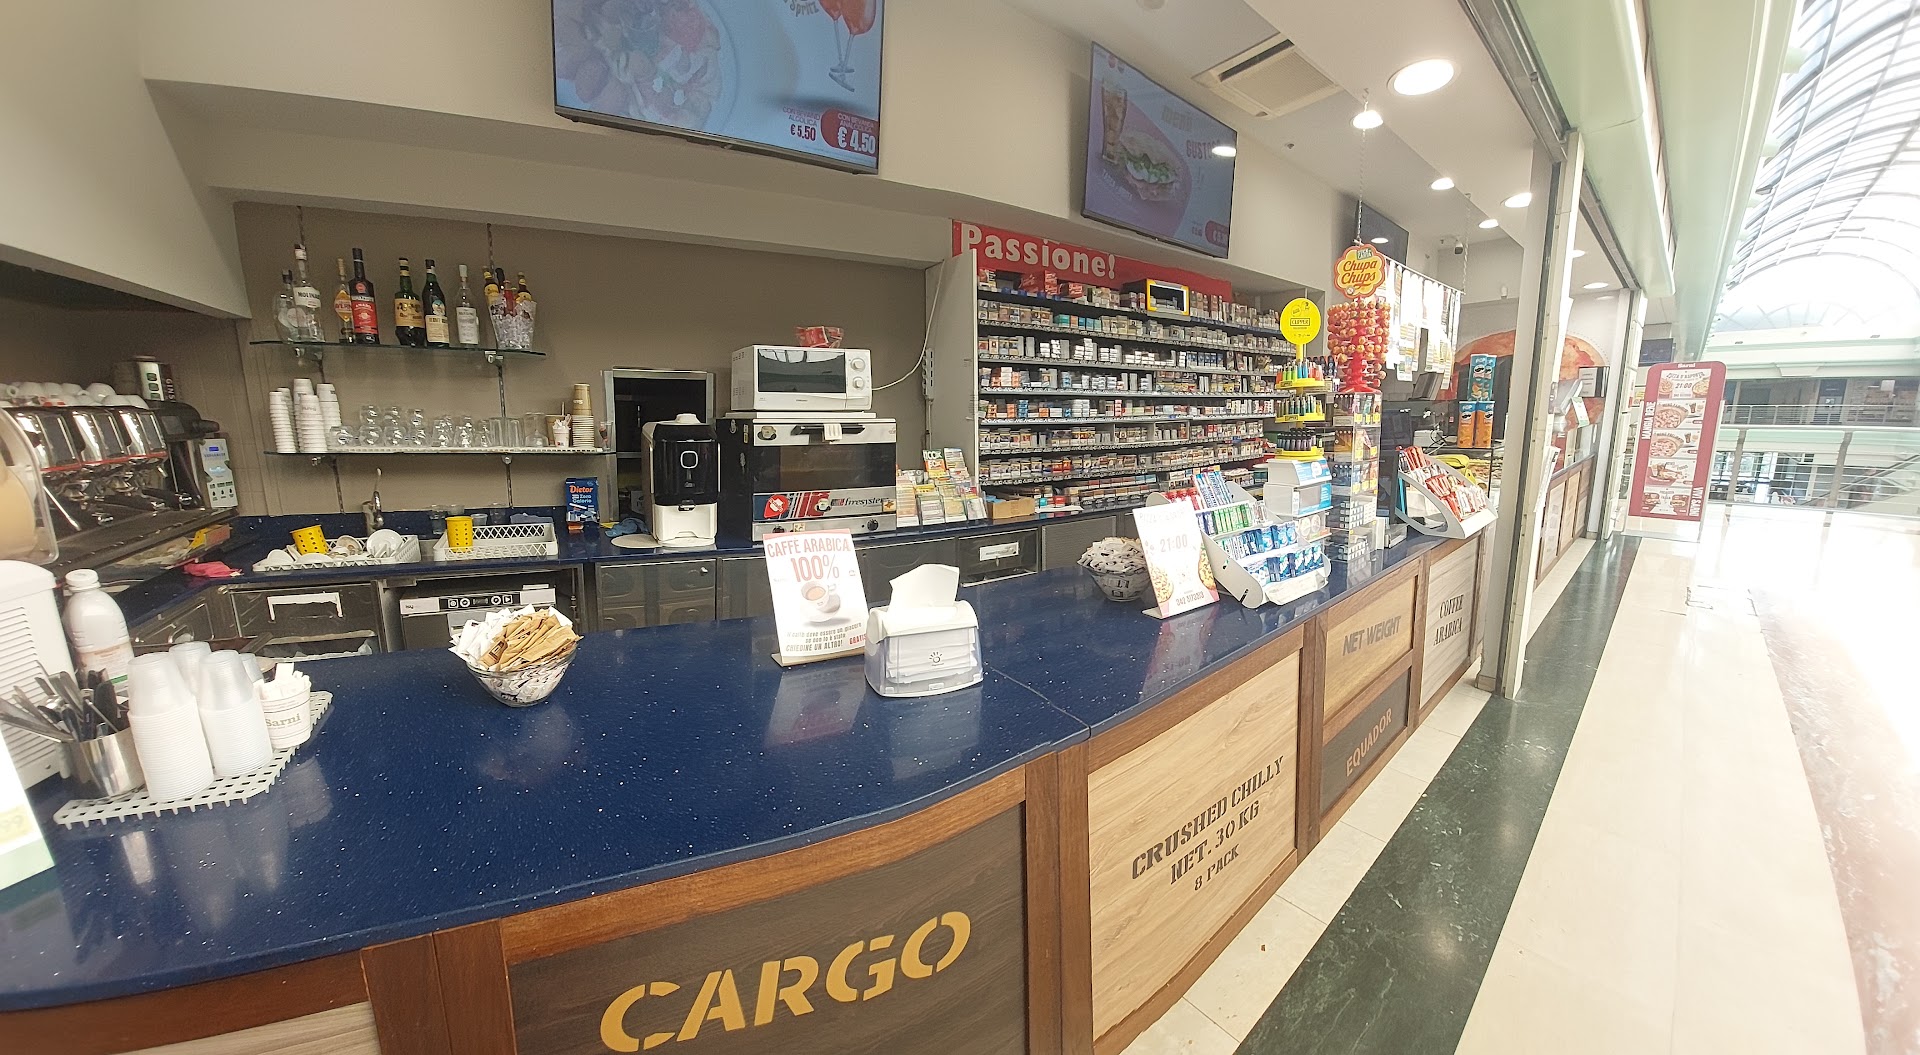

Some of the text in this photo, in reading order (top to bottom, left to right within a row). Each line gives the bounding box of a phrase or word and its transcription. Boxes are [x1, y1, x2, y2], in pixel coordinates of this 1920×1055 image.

[790, 124, 816, 141] € 5.50
[837, 126, 875, 154] € 4.50
[961, 223, 1115, 280] Passione!
[1341, 271, 1376, 288] Chups
[1343, 260, 1377, 273] Chupa
[569, 485, 594, 494] Dietor
[843, 497, 890, 508] firesyste
[767, 537, 851, 557] CAFFÈ ARABICA
[1160, 534, 1188, 553] 21:00
[790, 554, 840, 582] 100%
[1440, 594, 1464, 618] COFFEE
[1342, 615, 1402, 656] NET WEIGHT
[1433, 617, 1462, 646] ARABICA
[265, 713, 301, 727] Sarni
[1346, 708, 1392, 777] EQUADOR
[1132, 755, 1284, 880] CRUSHED CHILLY
[1171, 800, 1260, 885] NET. 30 KG
[1194, 843, 1240, 891] 8 PACK
[600, 910, 971, 1053] CARGO
